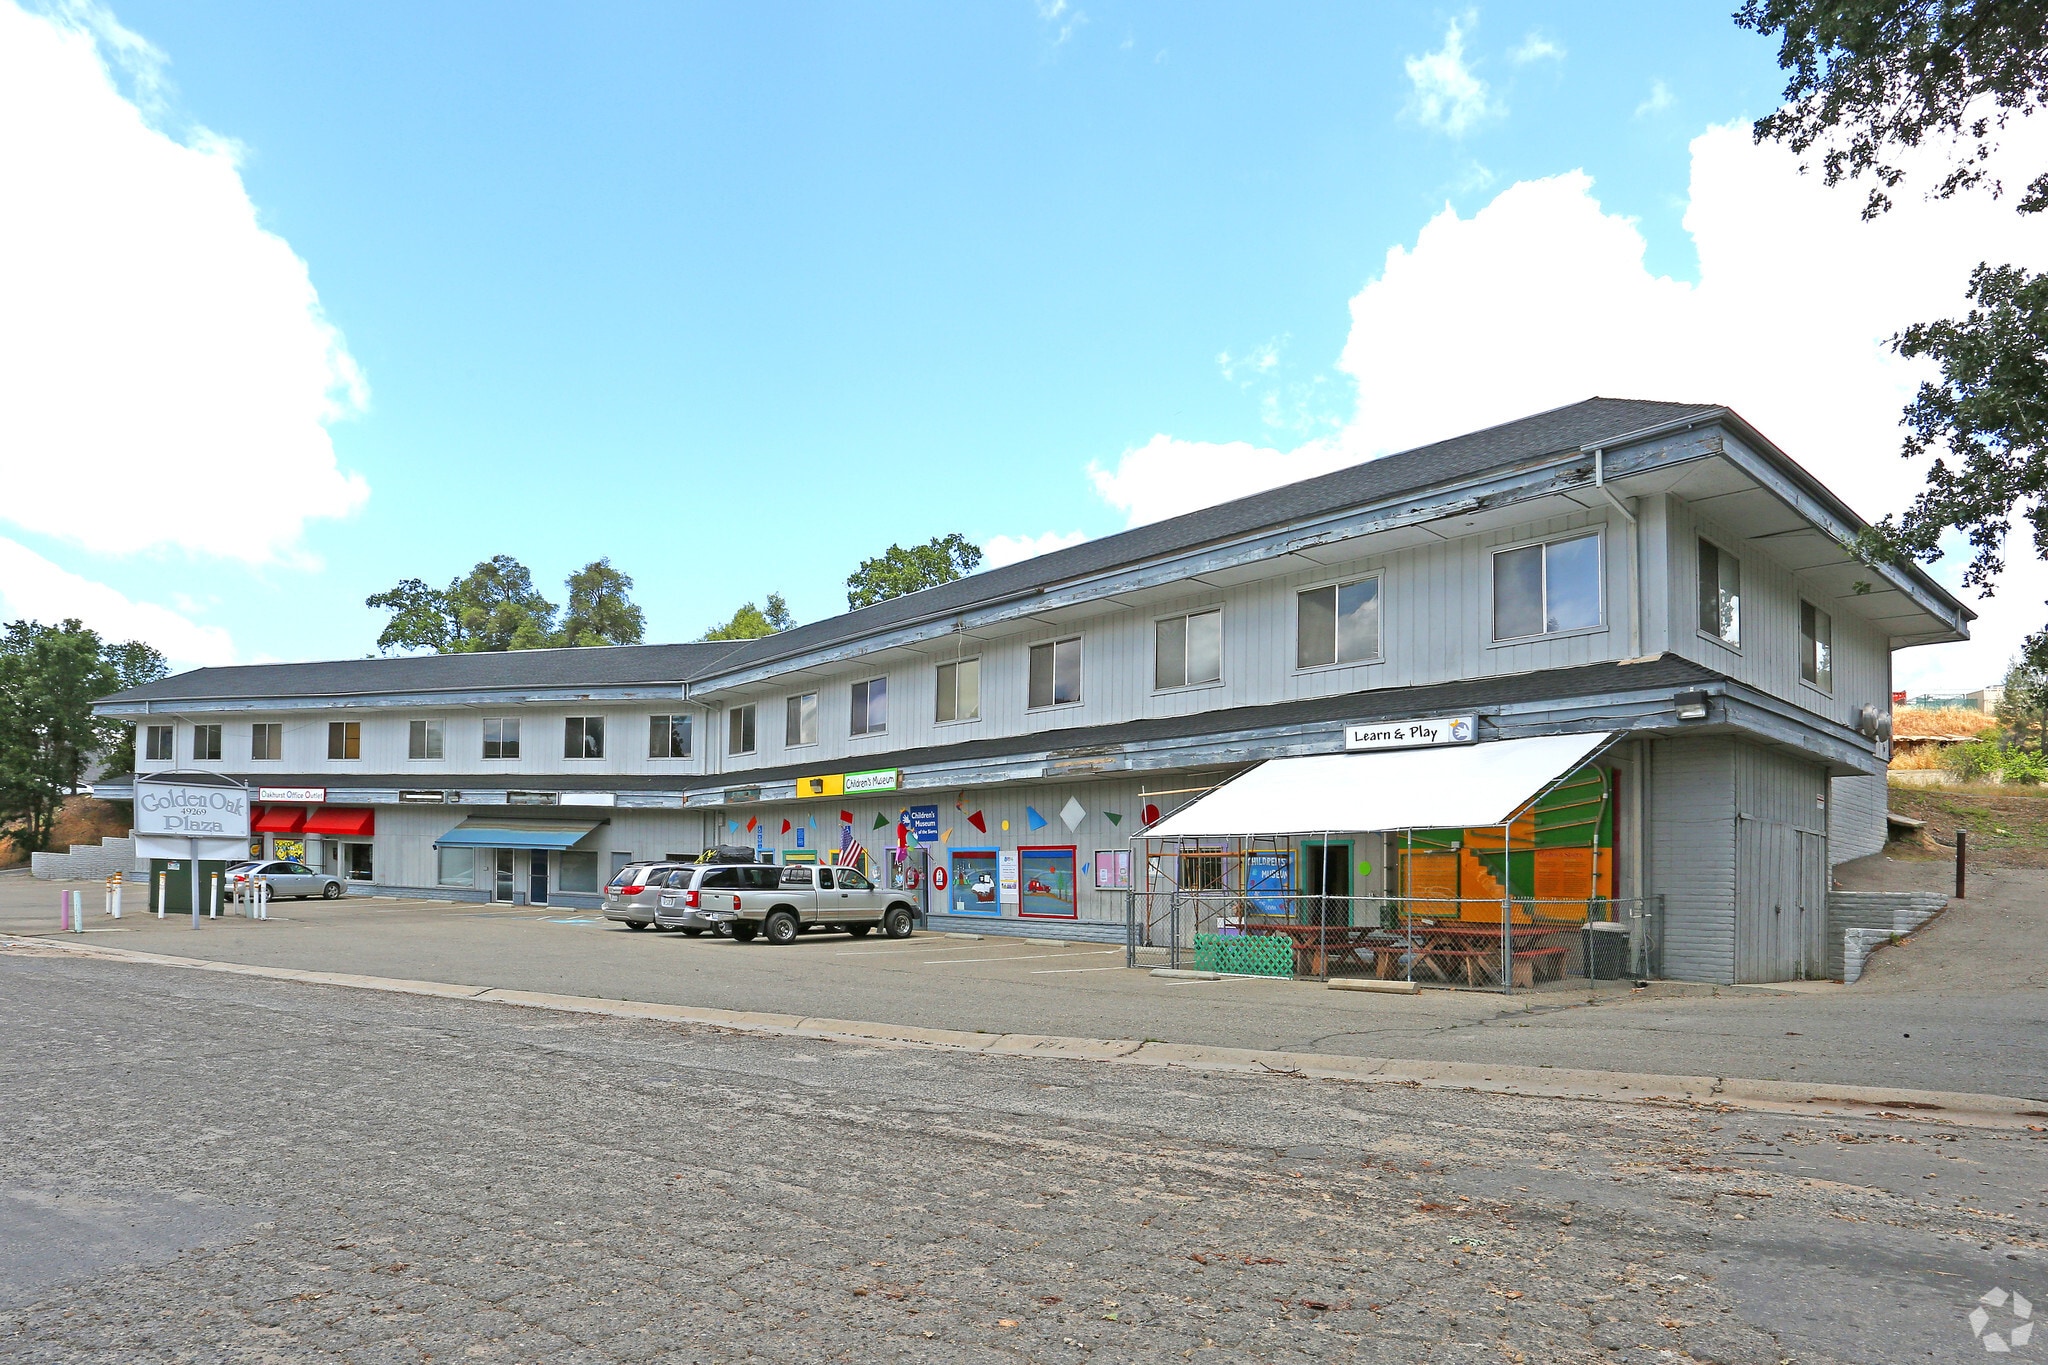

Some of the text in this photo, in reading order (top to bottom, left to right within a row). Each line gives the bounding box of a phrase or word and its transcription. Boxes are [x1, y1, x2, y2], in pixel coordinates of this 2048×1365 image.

[1354, 725, 1438, 742] Learn & Play
[846, 776, 895, 790] Children's Museum
[141, 788, 244, 816] Golden Oak
[261, 790, 323, 800] Oakhurst Office Outlet
[911, 811, 935, 819] Children's
[163, 815, 224, 832] Plaza
[915, 820, 936, 828] Museum
